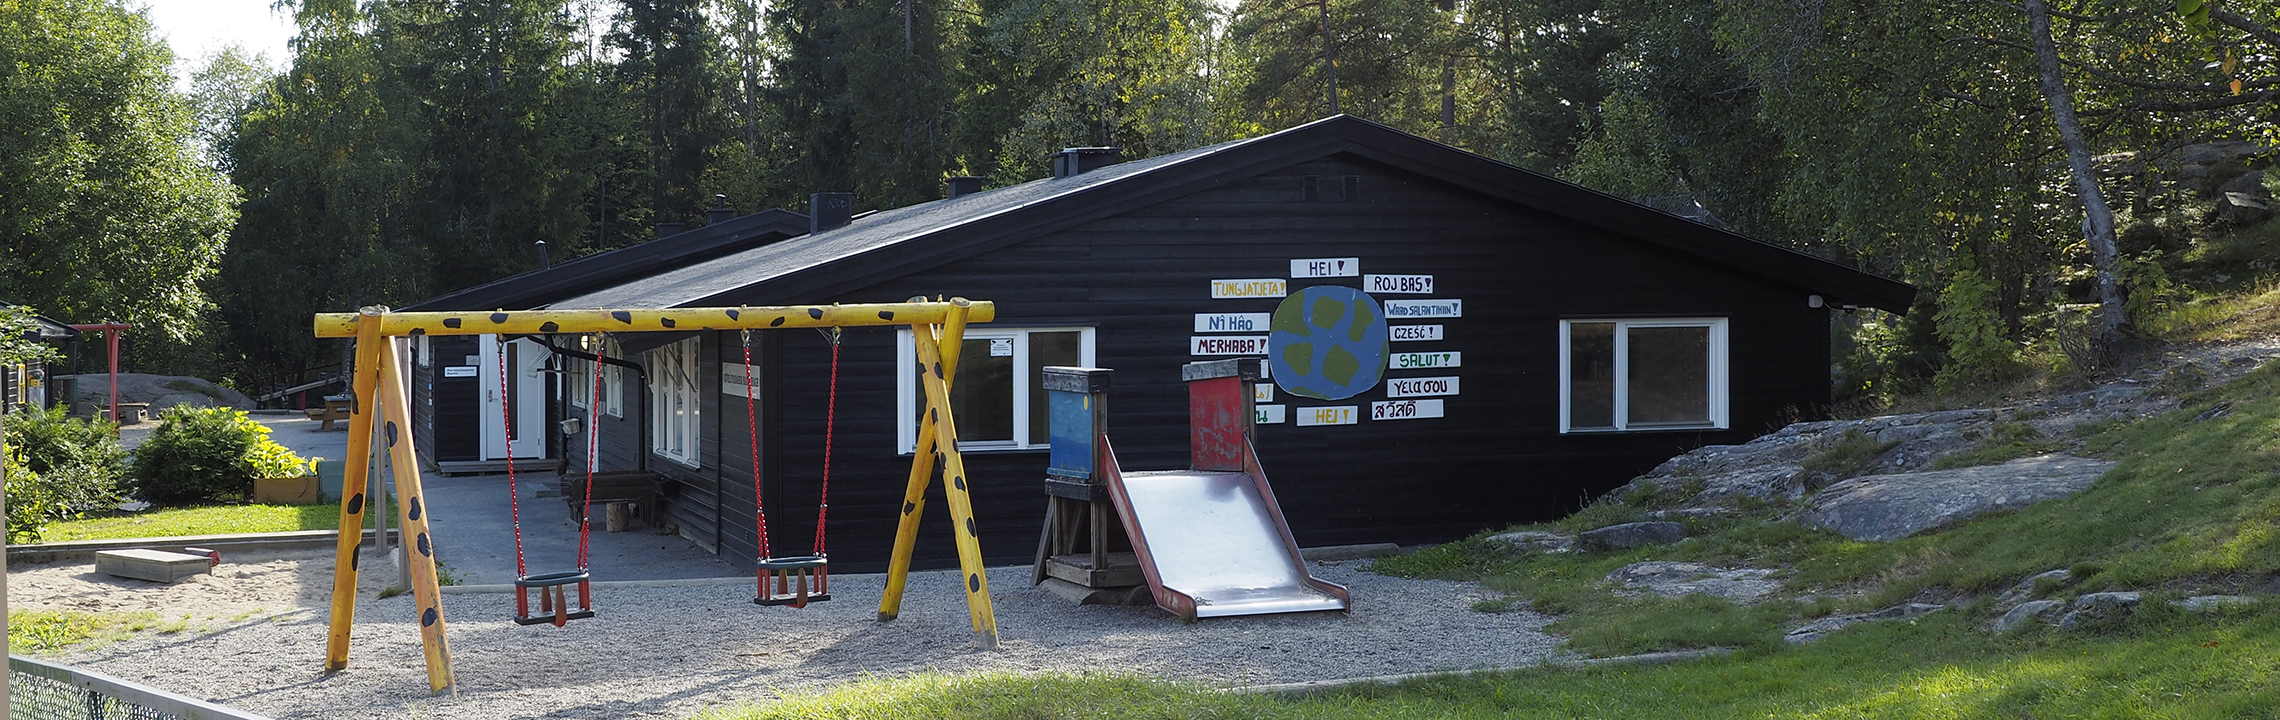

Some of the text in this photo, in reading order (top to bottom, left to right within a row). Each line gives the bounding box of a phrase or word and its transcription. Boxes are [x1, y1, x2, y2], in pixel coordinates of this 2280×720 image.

[1309, 261, 1331, 276] HEI
[1374, 276, 1397, 291] ROJ
[1394, 325, 1425, 339] CZEŚĆ
[1197, 339, 1255, 354] MERHABA
[1399, 354, 1440, 367] SALUT
[1316, 408, 1338, 424] HEJ
